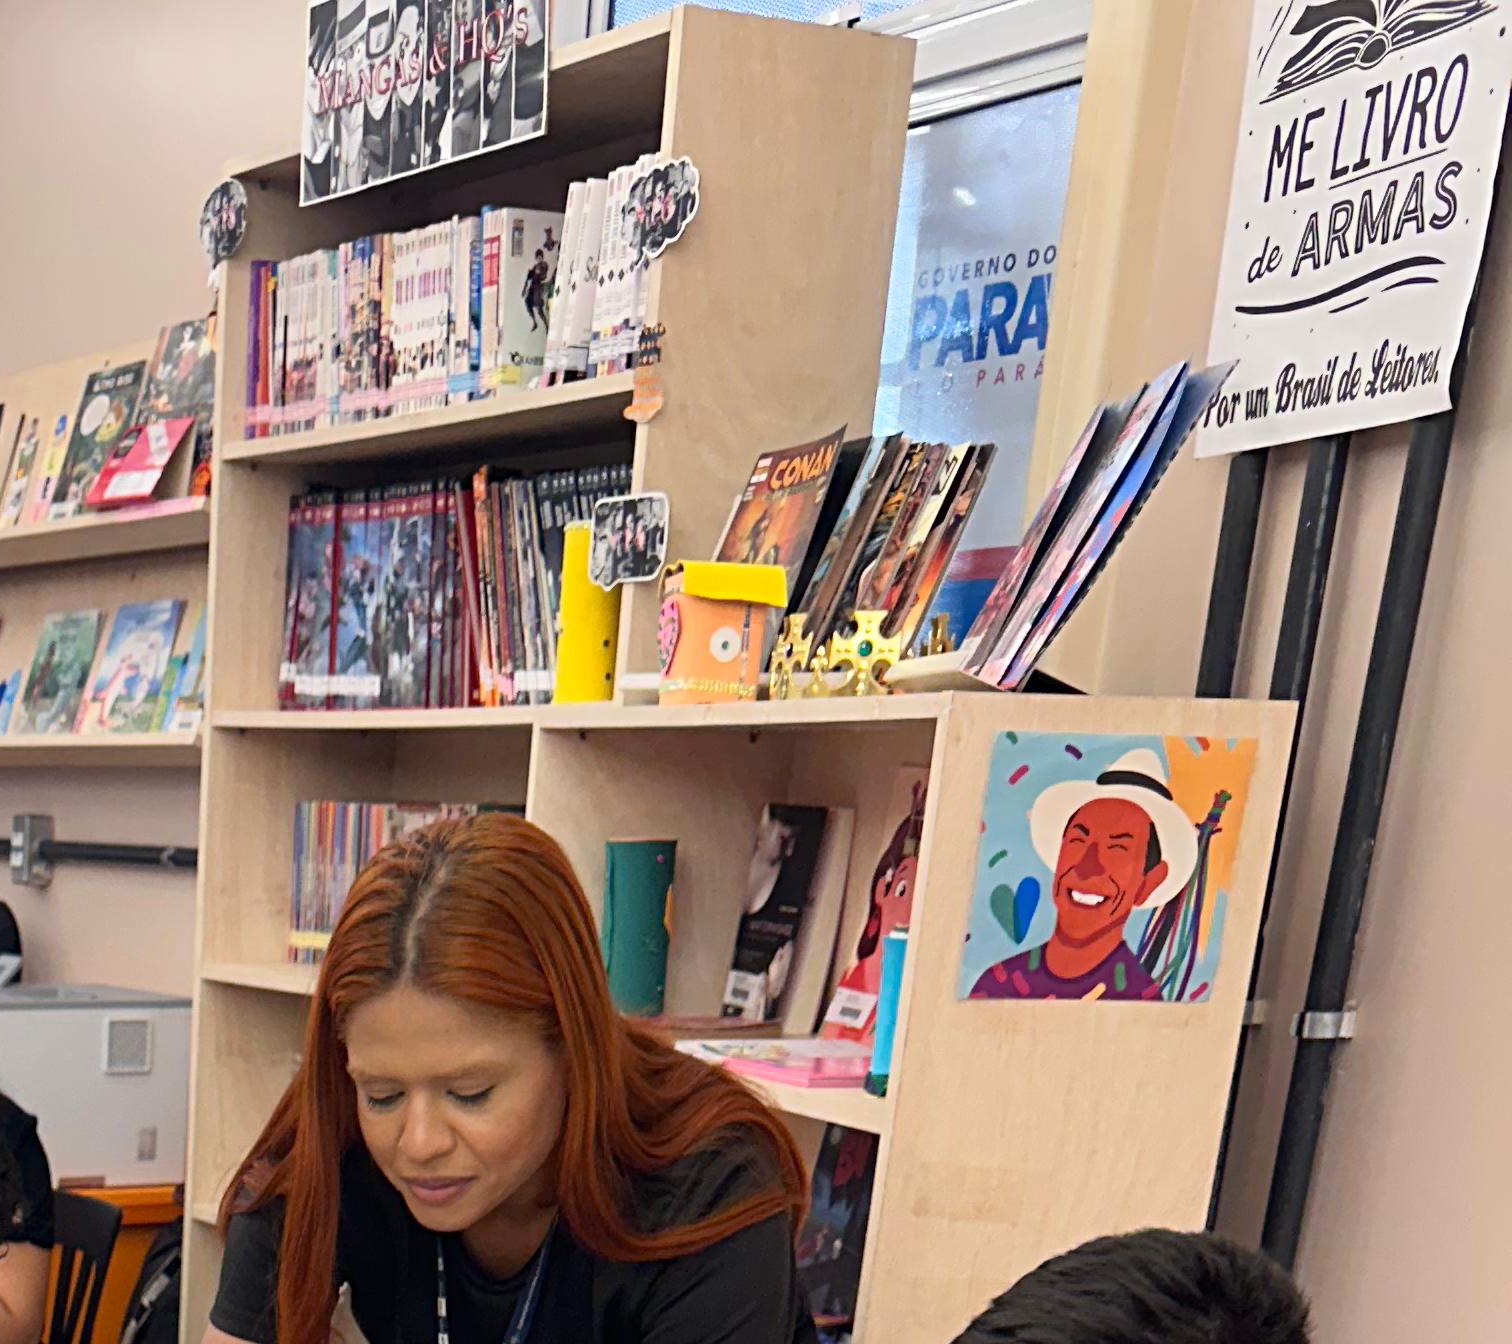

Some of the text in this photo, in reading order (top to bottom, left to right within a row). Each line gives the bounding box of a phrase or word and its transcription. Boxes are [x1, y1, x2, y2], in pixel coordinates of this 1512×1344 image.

[430, 32, 448, 75] &
[1264, 54, 1469, 202] ME LIVRO
[1248, 161, 1463, 283] de ARMAS
[917, 245, 1057, 290] GOVERNO DO
[1245, 386, 1270, 421] um
[1275, 355, 1339, 414] Brasil
[1337, 351, 1361, 403] de
[769, 443, 837, 491] CONAN
